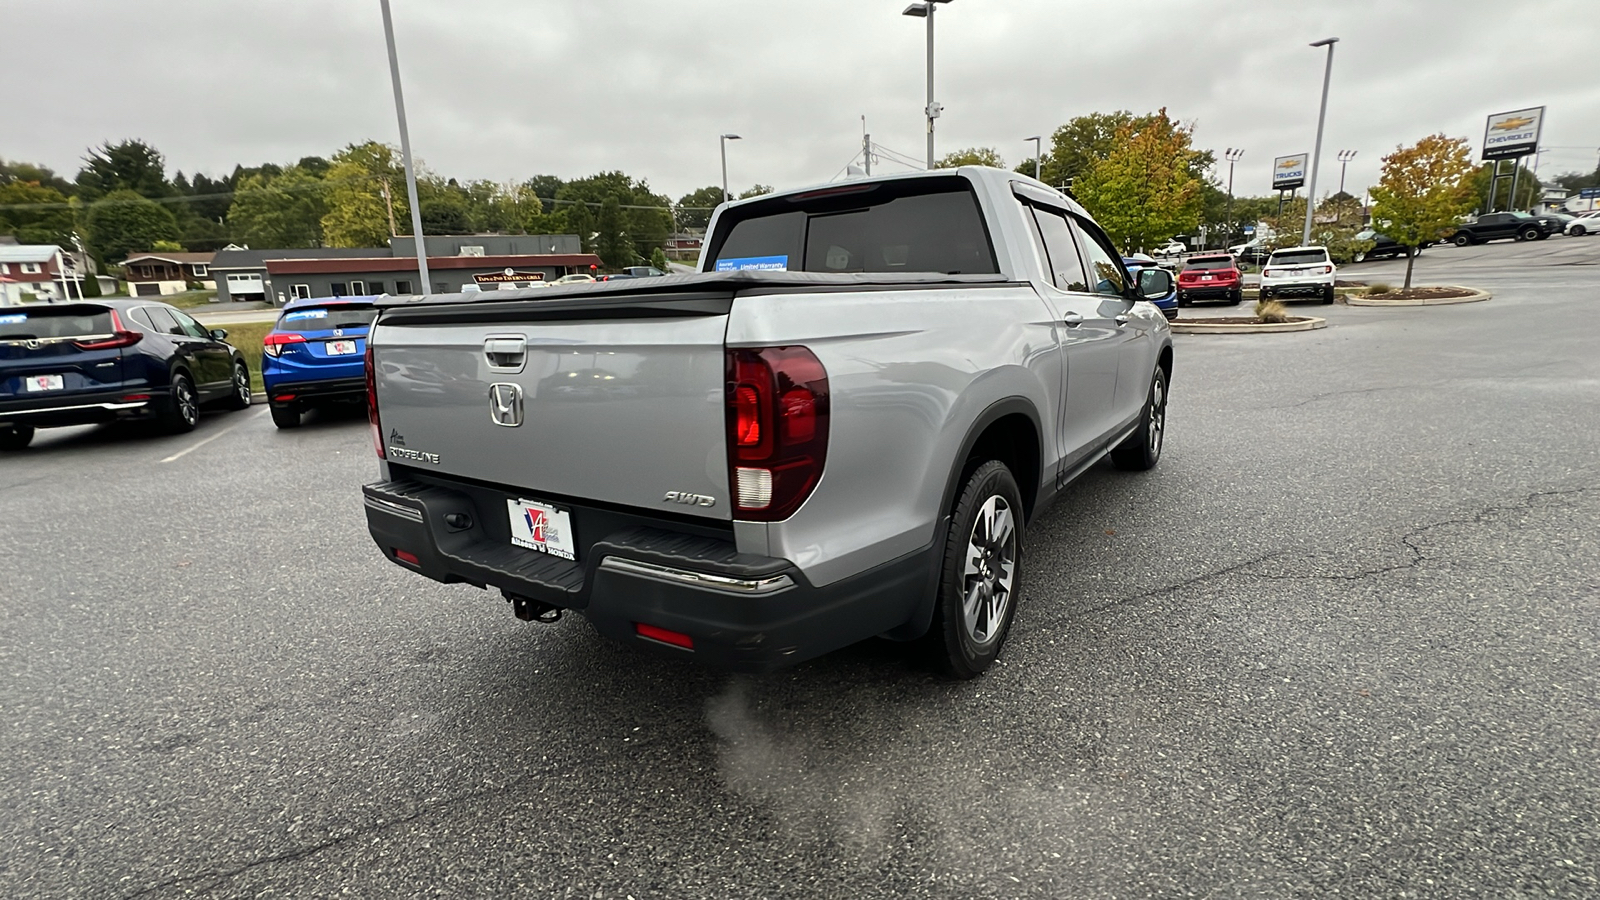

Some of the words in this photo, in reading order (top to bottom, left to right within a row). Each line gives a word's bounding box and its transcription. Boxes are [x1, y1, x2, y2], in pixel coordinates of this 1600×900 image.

[1488, 132, 1533, 144] CHEVROLET
[1276, 171, 1302, 179] TRUCKS
[389, 446, 441, 464] RIDGELINE
[662, 490, 716, 508] AWD
[547, 547, 575, 561] HONDA
